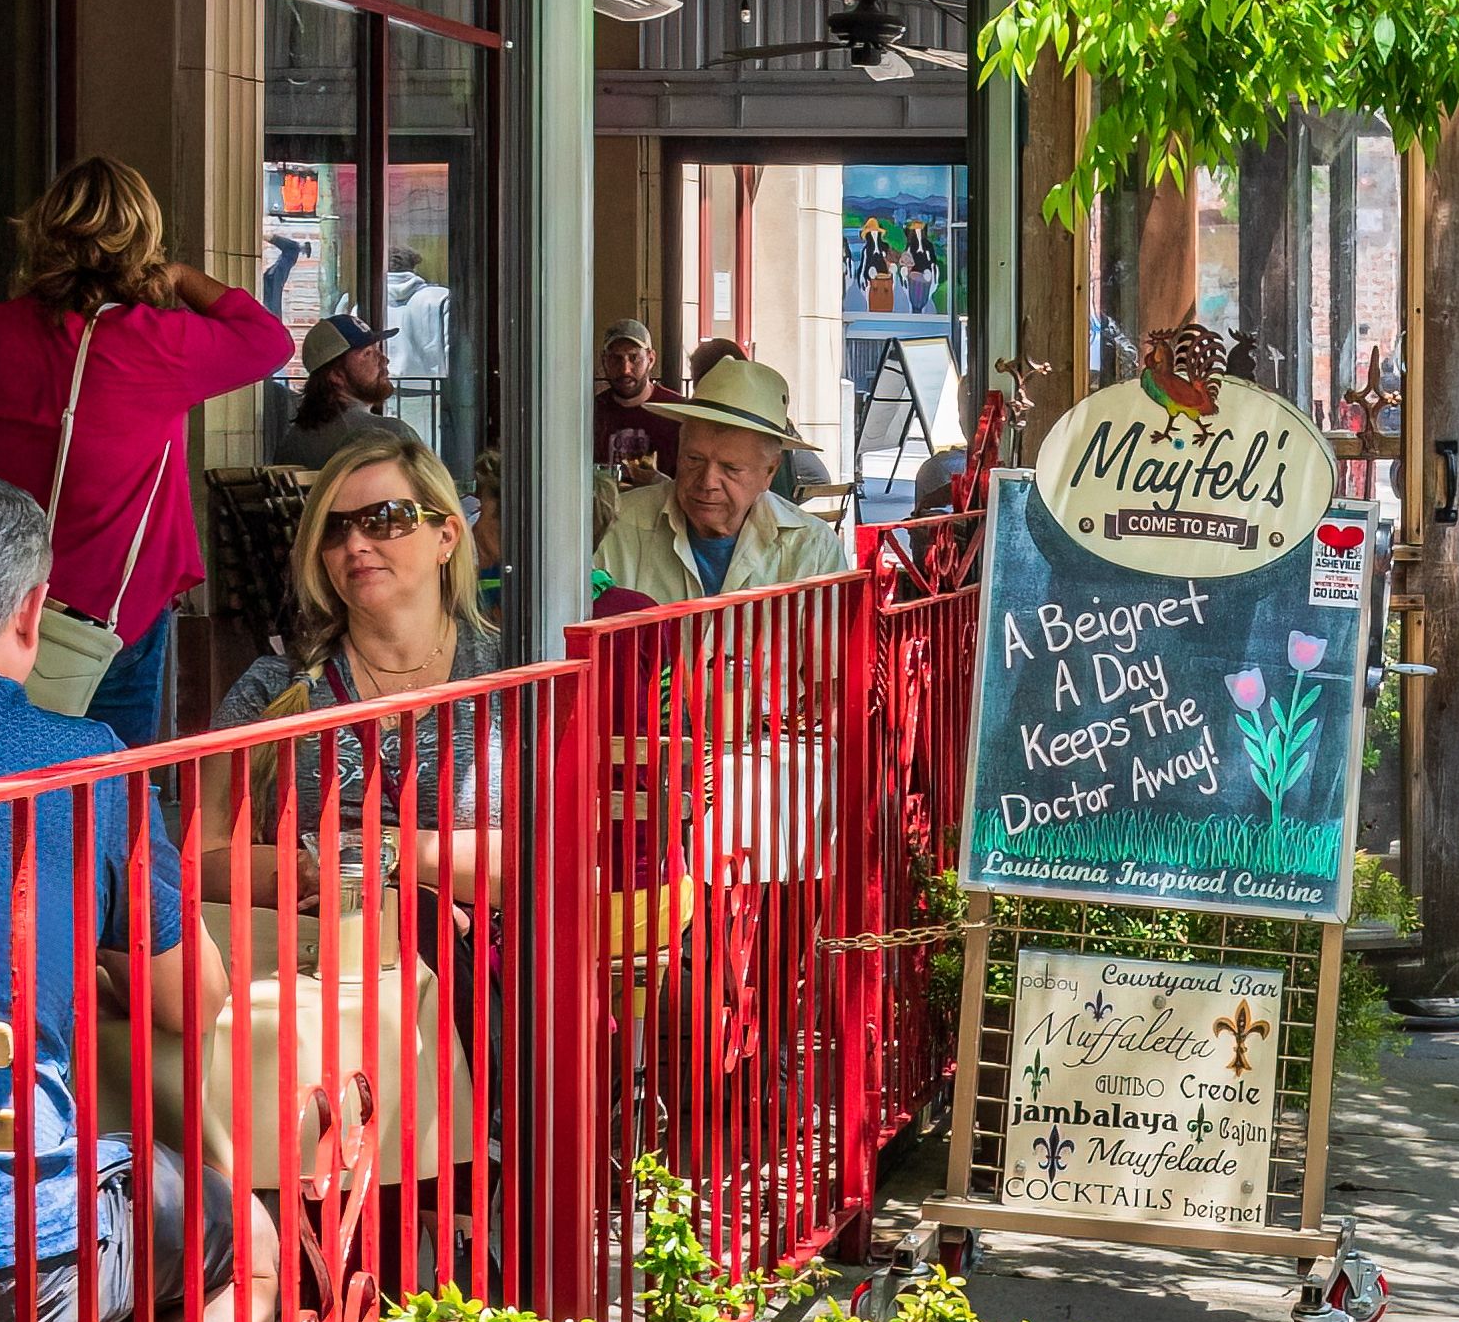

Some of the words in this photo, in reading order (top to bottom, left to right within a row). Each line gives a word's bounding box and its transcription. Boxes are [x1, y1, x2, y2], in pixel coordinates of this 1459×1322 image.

[1071, 421, 1287, 511] Mayfel's
[1128, 516, 1177, 532] COME
[1180, 517, 1203, 534] TO
[1206, 521, 1238, 539] EAT
[1315, 558, 1361, 570] ASHEVILLE
[1313, 587, 1327, 598] GO
[1328, 588, 1359, 601] LOCAL
[1004, 610, 1033, 667] A
[1039, 581, 1208, 657] Beignet
[1055, 660, 1080, 711] A
[1094, 653, 1169, 706] Day
[1021, 714, 1129, 772] Keeps
[1129, 697, 1203, 738] The
[1001, 779, 1112, 836] Doctor
[1131, 726, 1222, 802] Away!
[981, 851, 1109, 885] Louisiana
[1116, 861, 1227, 897] Inspired
[1233, 873, 1324, 904] Cuisine
[1020, 964, 1079, 1001] poboy
[1102, 964, 1223, 995] Courtyard
[1230, 974, 1279, 998] Bar
[1024, 1008, 1215, 1068] Muffaletta
[1095, 1075, 1165, 1098] GUMBO
[1180, 1074, 1261, 1104] Creole
[1011, 1097, 1179, 1134] jambalaya
[1218, 1117, 1268, 1147] Cajun
[1087, 1137, 1238, 1178] Mayfelade
[1005, 1177, 1173, 1210] COCKTAILS
[1183, 1197, 1263, 1223] beignet
